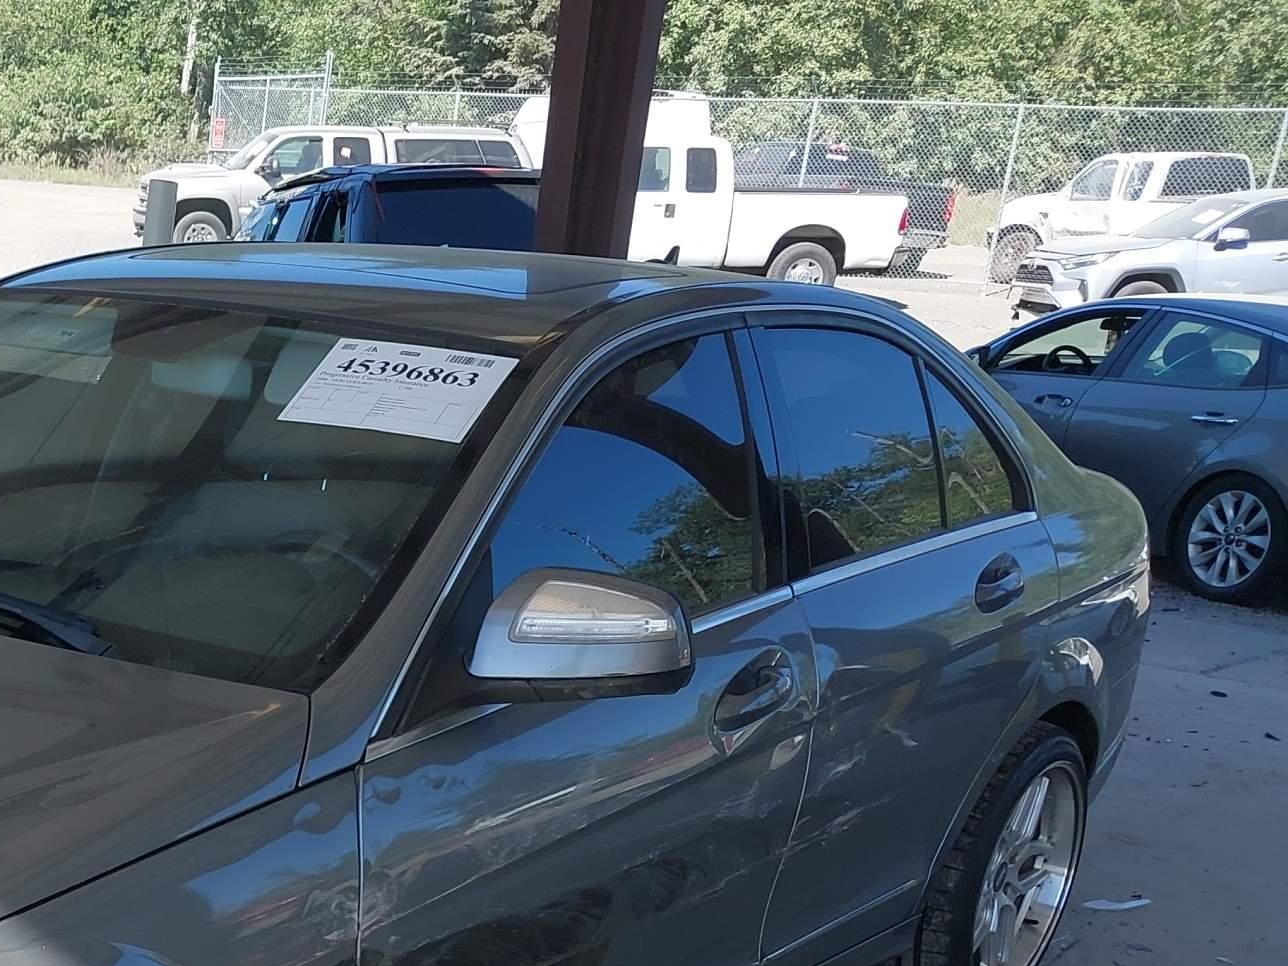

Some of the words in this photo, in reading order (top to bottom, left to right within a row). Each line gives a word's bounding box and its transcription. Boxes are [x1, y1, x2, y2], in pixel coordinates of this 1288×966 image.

[319, 370, 362, 381] Progressive
[361, 374, 393, 384] Casualty
[394, 378, 430, 388] Insurance
[336, 357, 480, 387] 45396863
